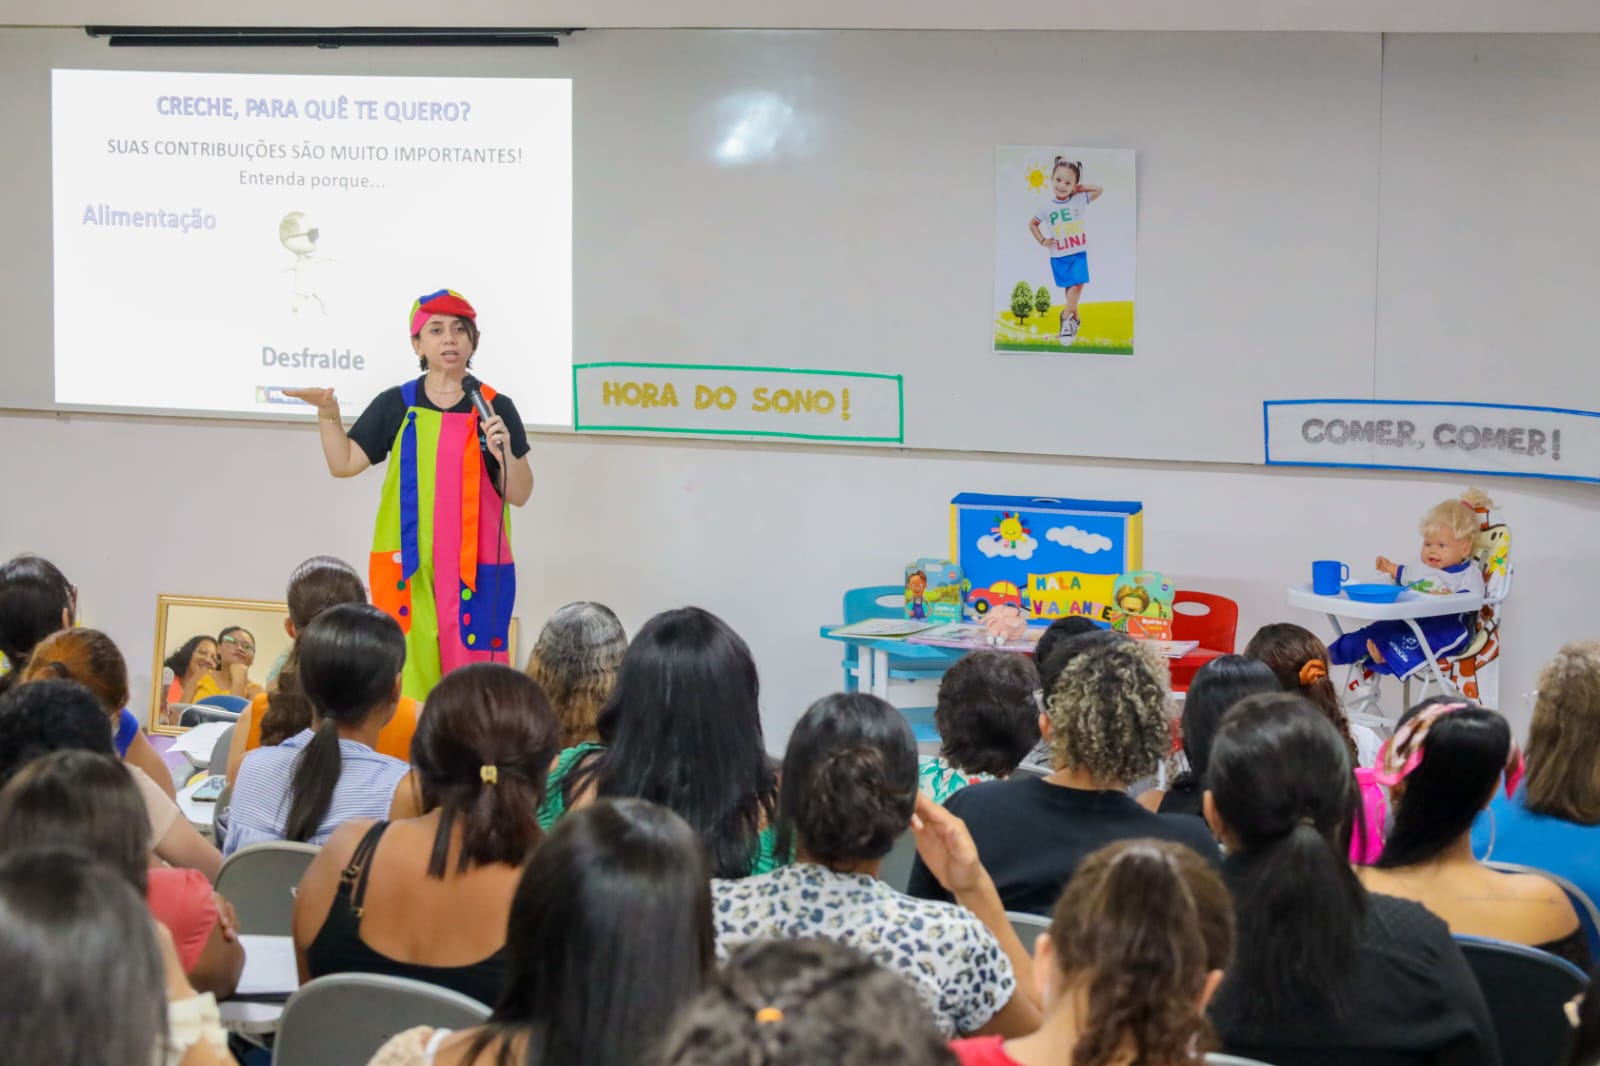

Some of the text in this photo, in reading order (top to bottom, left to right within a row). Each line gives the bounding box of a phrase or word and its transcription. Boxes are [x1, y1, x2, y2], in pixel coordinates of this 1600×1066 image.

[156, 94, 472, 123] CRECHE, PARA QUÊ TE QUERO?
[107, 138, 523, 165] SUAS CONTRIBUIÇÕES SÃO MUITO IMPORTANTES!
[239, 170, 386, 191] Entenda porque...
[82, 203, 217, 234] Alimentação
[262, 346, 365, 371] Desfralde
[602, 381, 851, 422] HORA DO SONO!
[1301, 418, 1562, 461] COMER, COMER!
